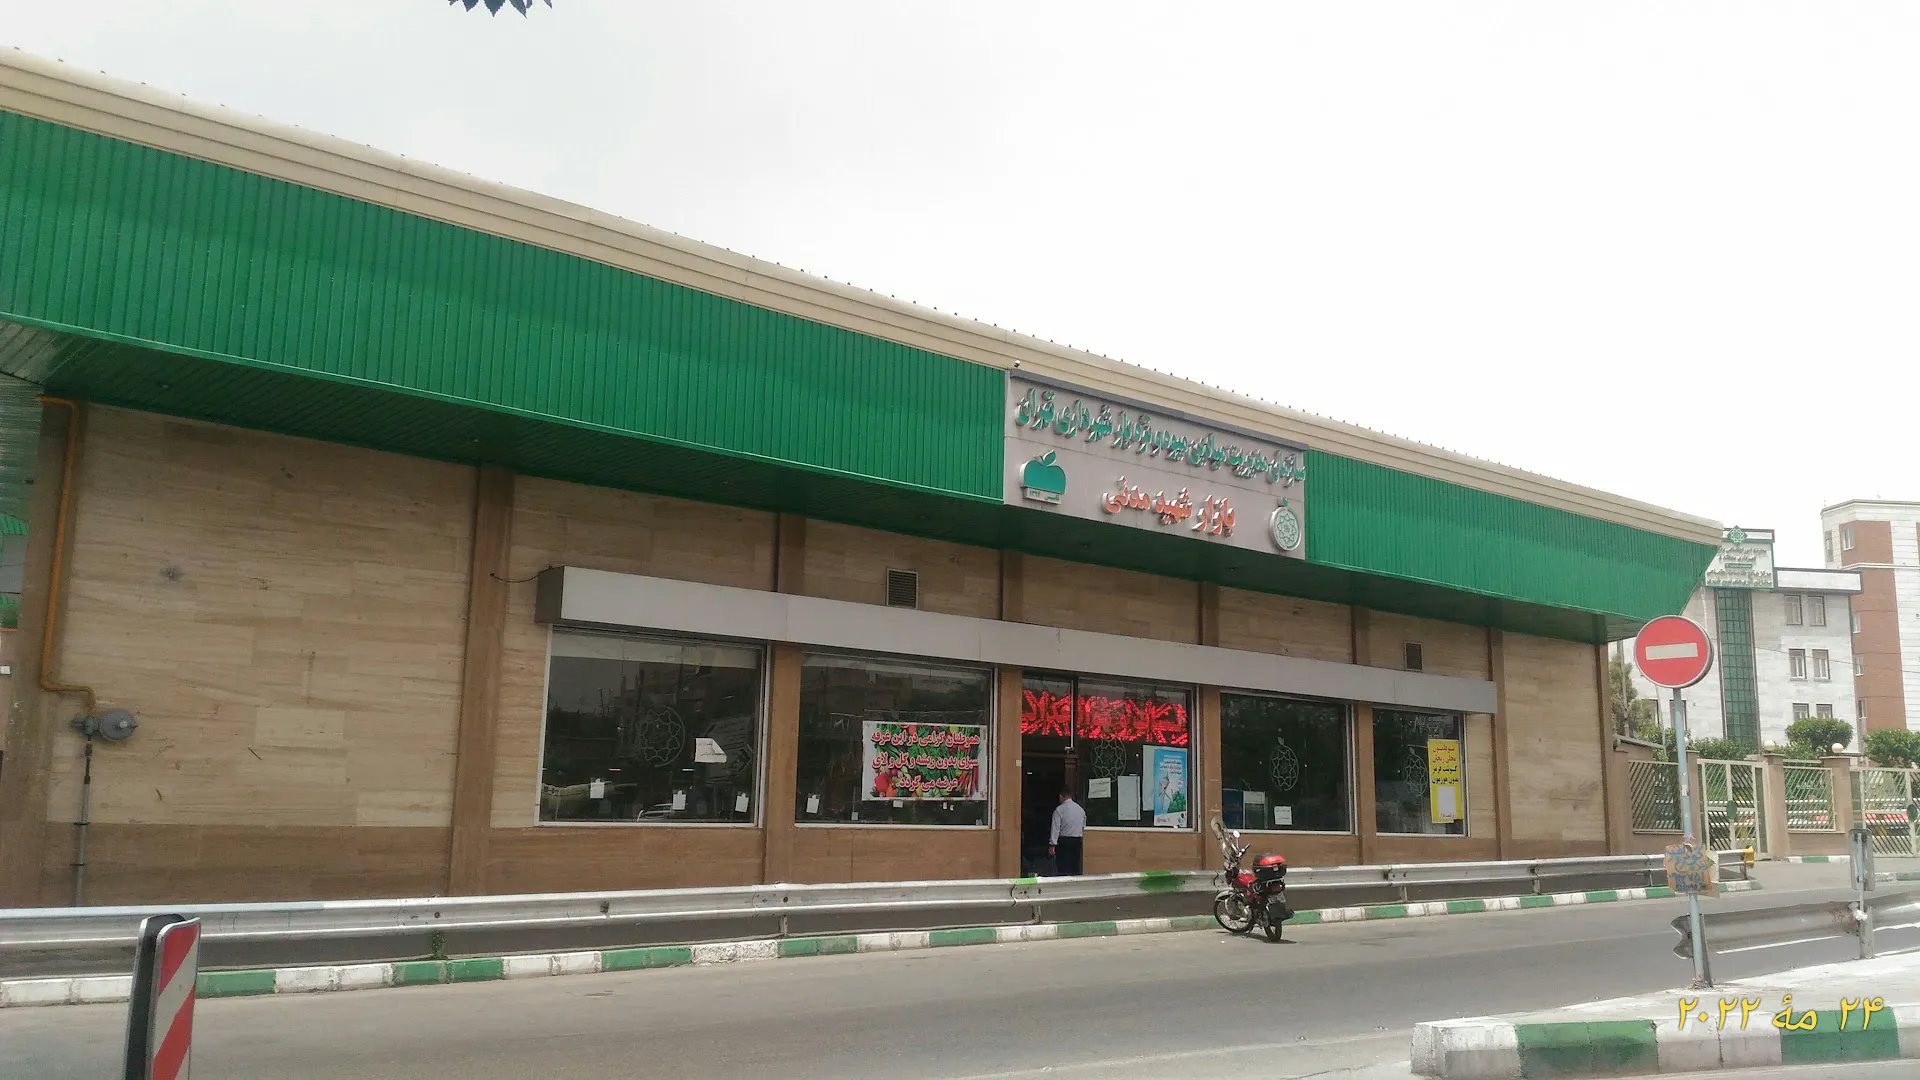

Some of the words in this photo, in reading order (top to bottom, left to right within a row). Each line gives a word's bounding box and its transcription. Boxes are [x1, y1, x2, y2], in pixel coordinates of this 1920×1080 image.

[1015, 387, 1056, 431] تهران
[1053, 399, 1113, 443] شهرداری
[1151, 430, 1162, 457] و
[1163, 430, 1188, 462] میوه
[1187, 433, 1227, 471] میادین
[1227, 445, 1268, 479] مدیریت
[1267, 450, 1306, 488] سازمان
[1101, 475, 1151, 514] مدنی
[1151, 487, 1193, 525] شهید
[1191, 494, 1235, 538] بازار
[872, 730, 891, 745] غرفه
[891, 730, 907, 746] این
[907, 732, 919, 746] در
[919, 731, 946, 746] گرامی
[946, 731, 980, 747] هموطنان
[872, 752, 889, 768] لای
[889, 758, 896, 768] و
[895, 752, 909, 768] گل
[908, 758, 916, 768] و
[916, 753, 935, 769] ریشه
[936, 755, 958, 769] بدون
[958, 755, 980, 770] سبزی
[921, 779, 936, 791] می
[936, 776, 958, 791] عرضه
